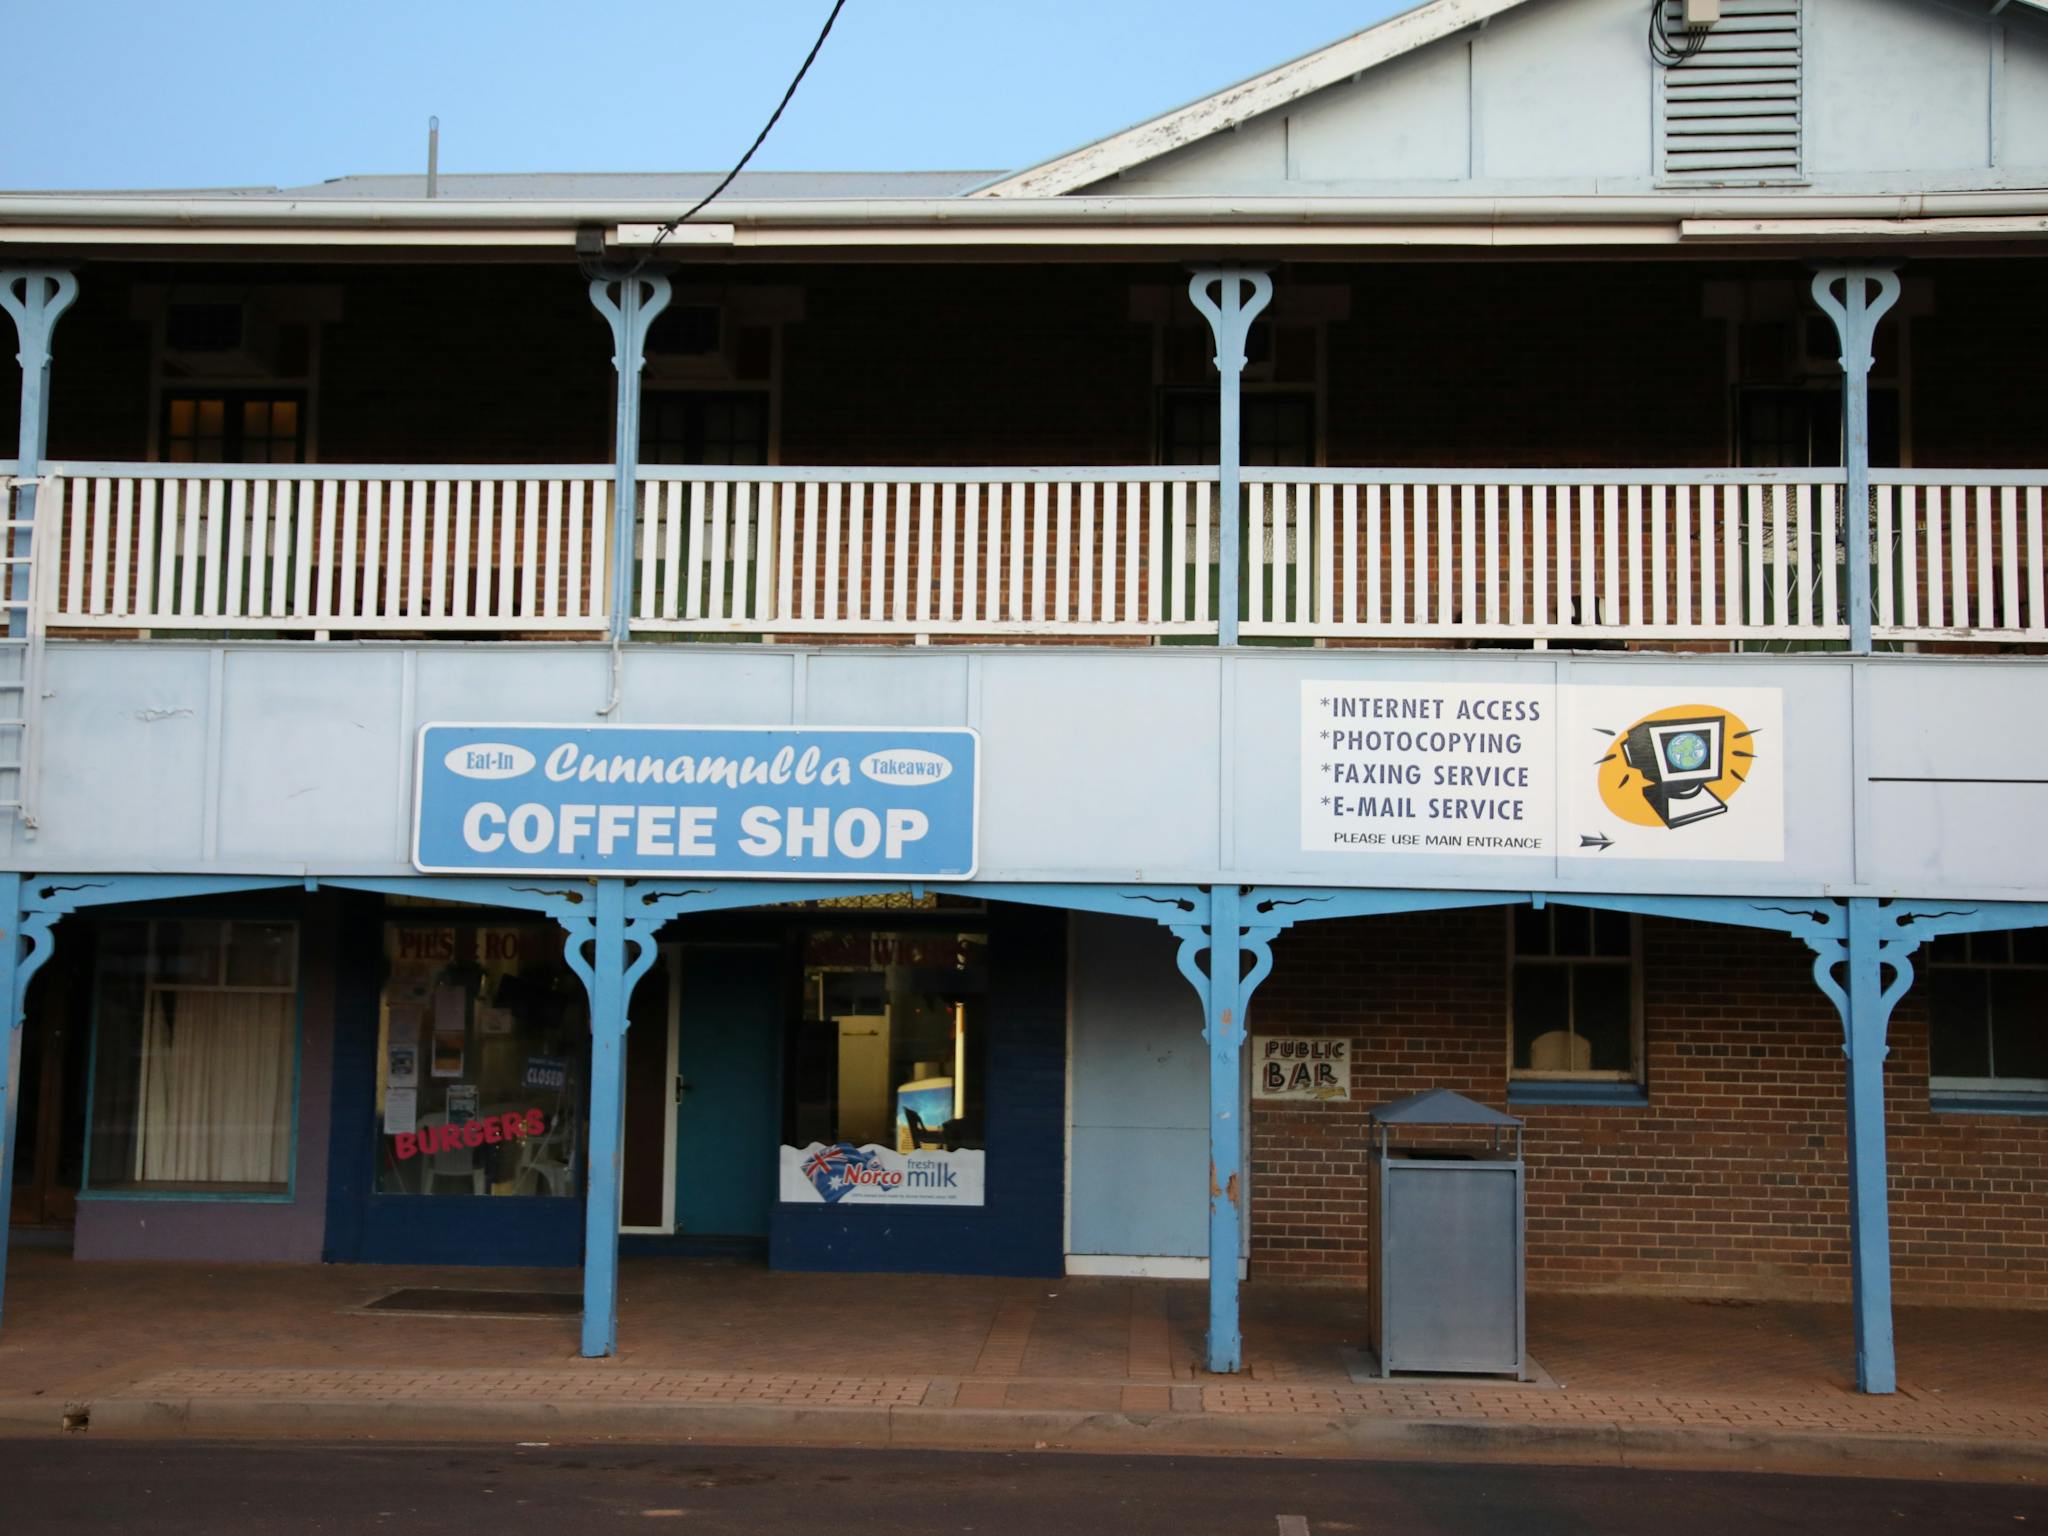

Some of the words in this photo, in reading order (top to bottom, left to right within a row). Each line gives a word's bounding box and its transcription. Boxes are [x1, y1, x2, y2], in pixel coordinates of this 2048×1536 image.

[1456, 699, 1541, 722] ACCESS
[465, 751, 515, 771] Eat-In
[544, 742, 851, 789] Cunnamulla
[871, 757, 944, 779] Takeaway
[1434, 765, 1529, 788] SERVICE
[1428, 798, 1525, 821] SERVICE
[463, 802, 718, 857] COFFEE
[737, 805, 930, 860] SHOP
[1334, 833, 1388, 846] PLEASE
[1391, 834, 1418, 846] USE
[1425, 835, 1462, 847] MAIN
[1466, 836, 1543, 849] ENTRANCE
[399, 931, 455, 960] PIES
[1265, 1040, 1345, 1059] PUBLIC
[526, 1066, 565, 1089] CLOSED
[1263, 1061, 1338, 1092] BAR
[394, 1108, 546, 1161] BURGERS
[843, 1163, 903, 1187] Norco
[907, 1158, 935, 1170] fresh
[907, 1162, 958, 1188] milk
